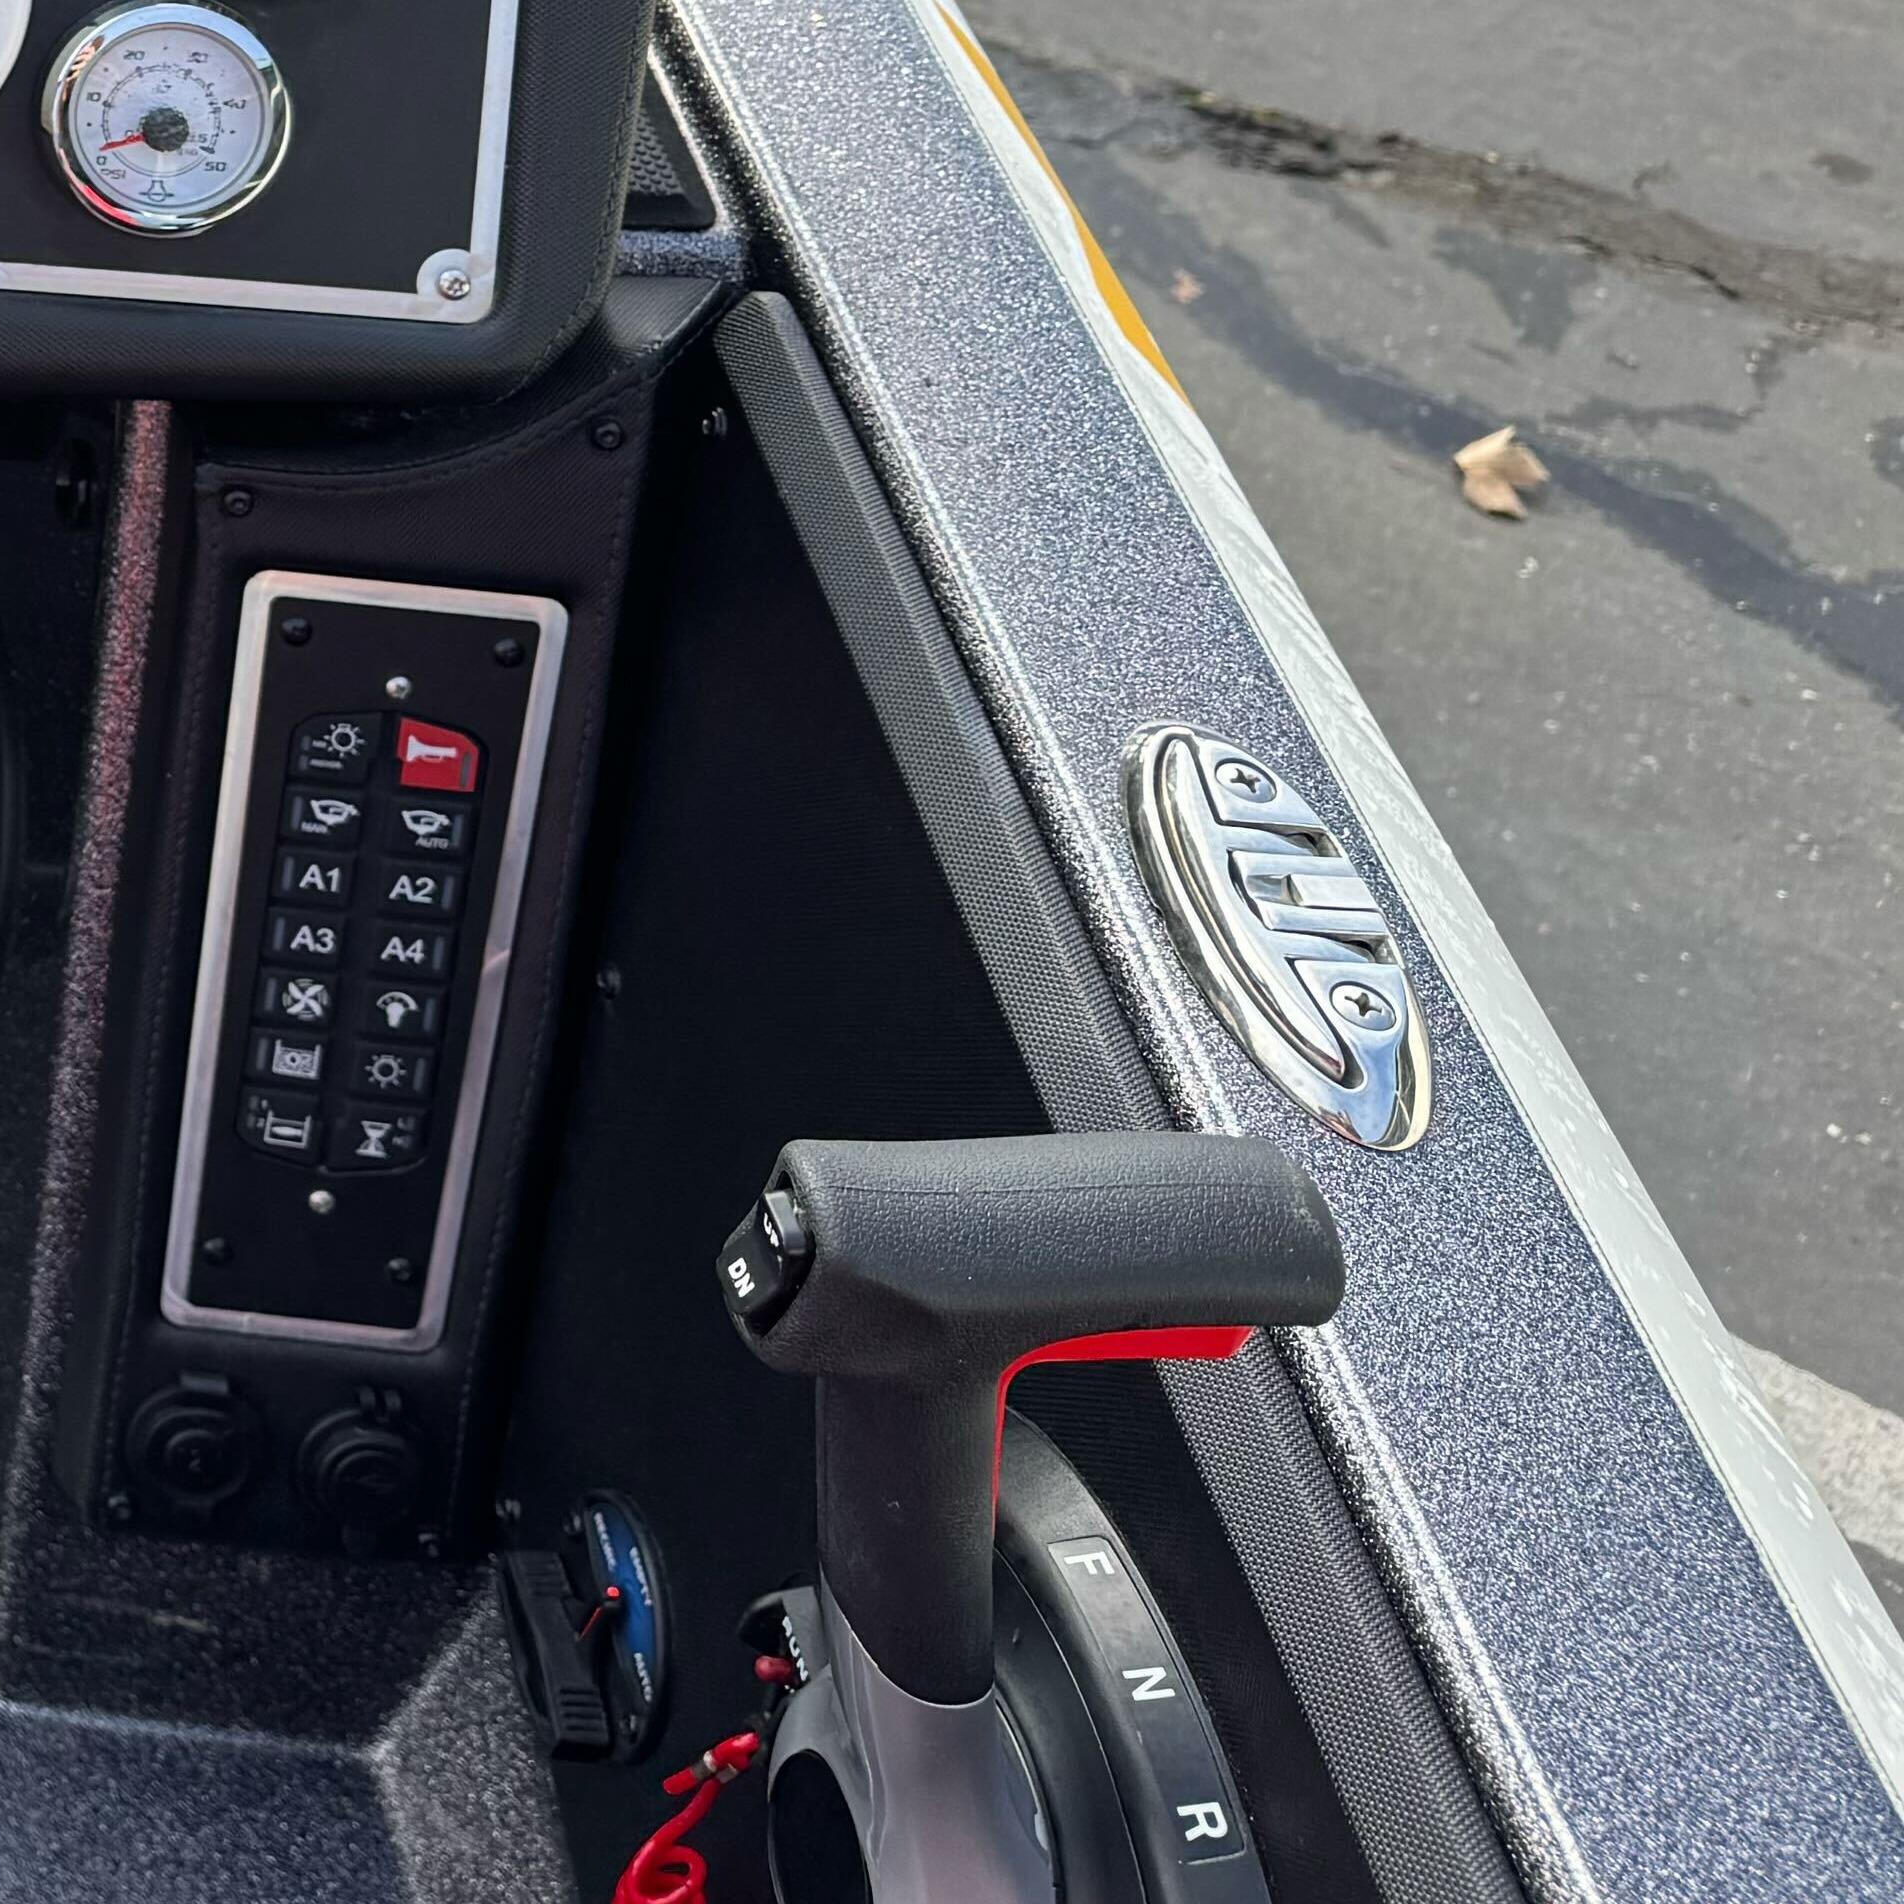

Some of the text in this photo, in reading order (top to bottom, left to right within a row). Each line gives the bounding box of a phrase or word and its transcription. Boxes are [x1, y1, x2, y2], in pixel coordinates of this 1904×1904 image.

[414, 836, 449, 850] AUTO
[299, 864, 341, 893] A1
[388, 874, 437, 904] A2
[290, 925, 336, 954] A3
[380, 936, 425, 964] A4
[727, 1257, 755, 1298] DN
[1063, 1551, 1116, 1576] F
[782, 1615, 809, 1682] RUN
[1122, 1666, 1176, 1701] N
[1176, 1801, 1229, 1842] R
